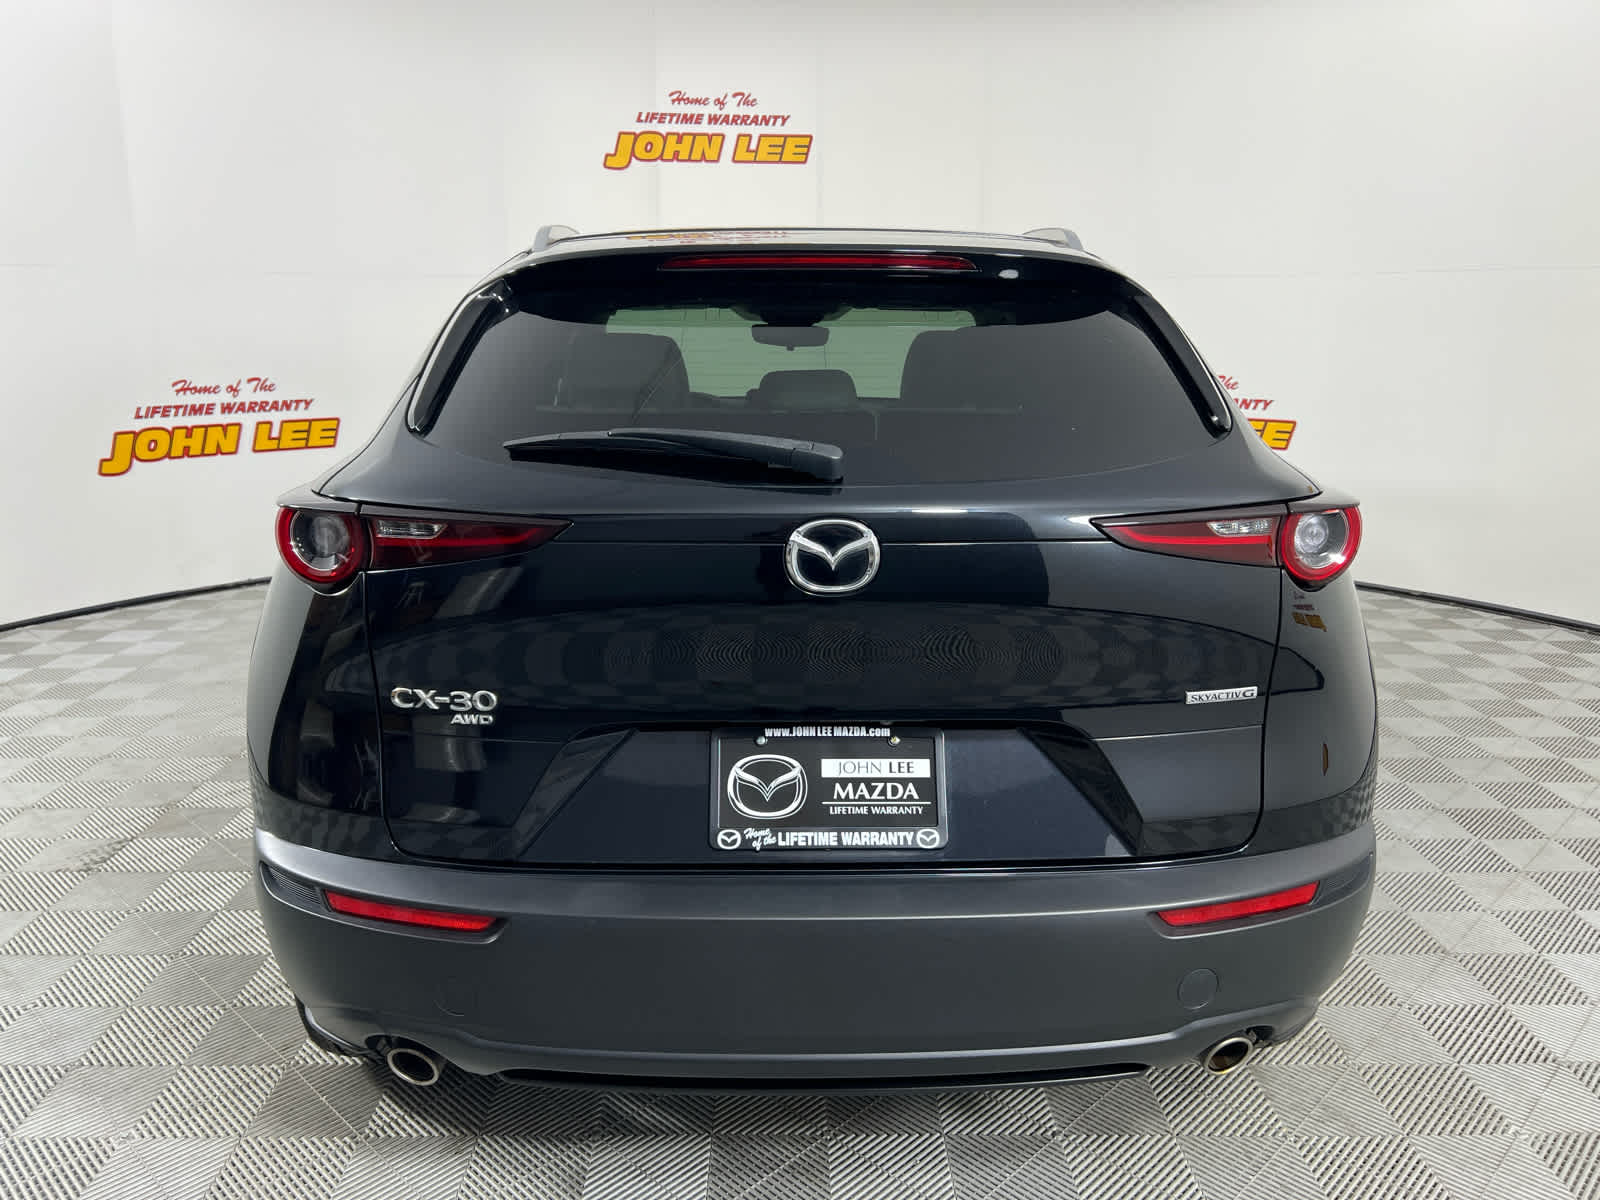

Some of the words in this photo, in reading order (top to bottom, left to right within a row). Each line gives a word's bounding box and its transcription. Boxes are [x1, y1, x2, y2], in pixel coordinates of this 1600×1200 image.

[668, 90, 710, 106] Home
[714, 93, 728, 110] of
[732, 91, 758, 107] The
[636, 111, 704, 125] LIFETIME
[707, 113, 791, 127] WARRANTY
[603, 130, 725, 171] JOHN
[731, 133, 813, 164] LEE
[171, 379, 221, 396] Home
[225, 379, 242, 398] of
[246, 377, 276, 393] The
[134, 403, 216, 420] LIFETIME
[220, 399, 315, 415] WARRANTY
[97, 422, 242, 477] JOHN
[252, 417, 340, 453] LEE
[391, 687, 498, 711] CX-30
[451, 713, 494, 725] AWD
[837, 760, 882, 777] JOHN
[889, 761, 915, 774] LEE
[833, 782, 919, 800] MAZDA
[829, 806, 869, 815] LIFETIME
[871, 806, 924, 815] WARRANTY
[744, 828, 770, 839] Home
[778, 831, 838, 846] LIFETIME
[841, 831, 914, 846] WARRANTY
[752, 837, 762, 851] of
[763, 834, 776, 845] the
